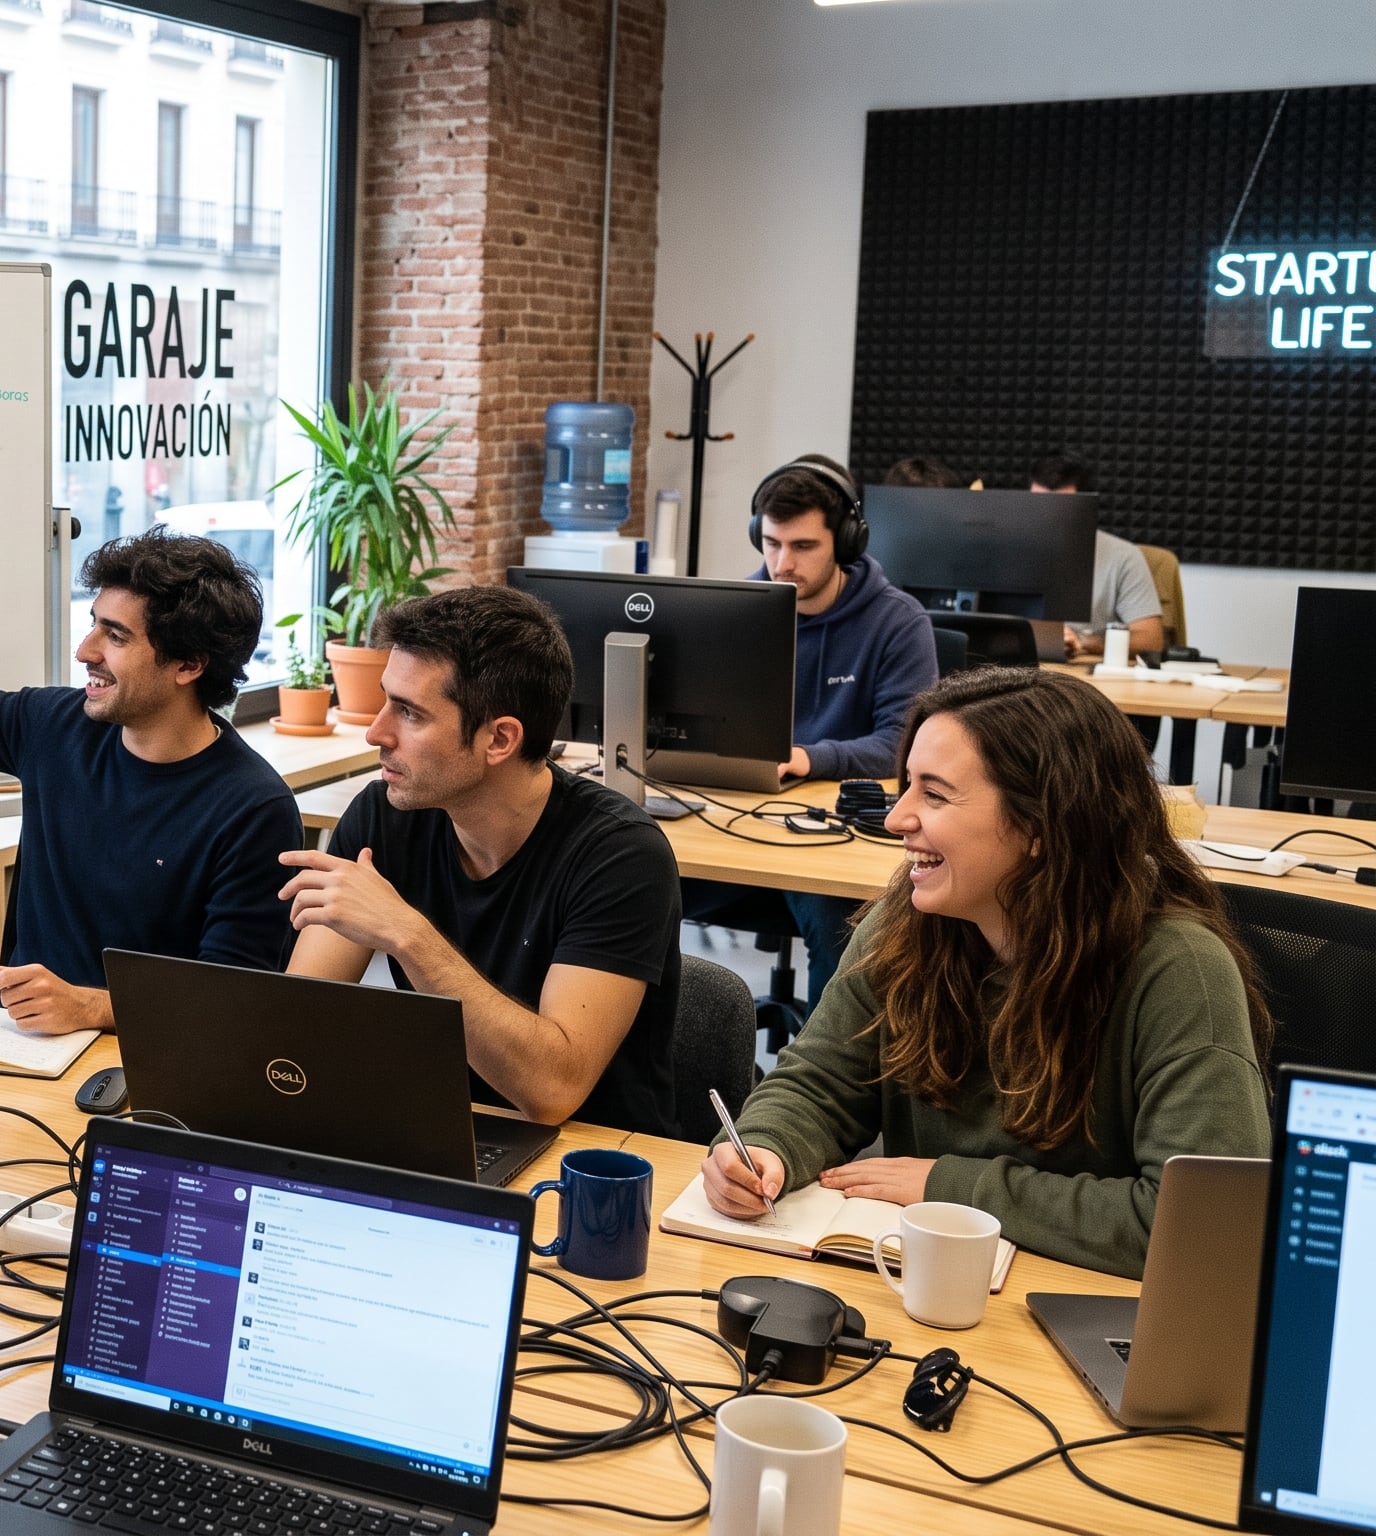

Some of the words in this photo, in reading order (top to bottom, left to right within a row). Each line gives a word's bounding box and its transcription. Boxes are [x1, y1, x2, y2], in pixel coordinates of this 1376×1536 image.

[1215, 251, 1376, 297] START
[64, 279, 235, 379] GARAJE
[1271, 306, 1374, 348] LIFE
[65, 390, 231, 462] INNOVACIÓN
[628, 602, 650, 612] DELL
[272, 1070, 303, 1084] DELL
[243, 1438, 272, 1455] DELL
